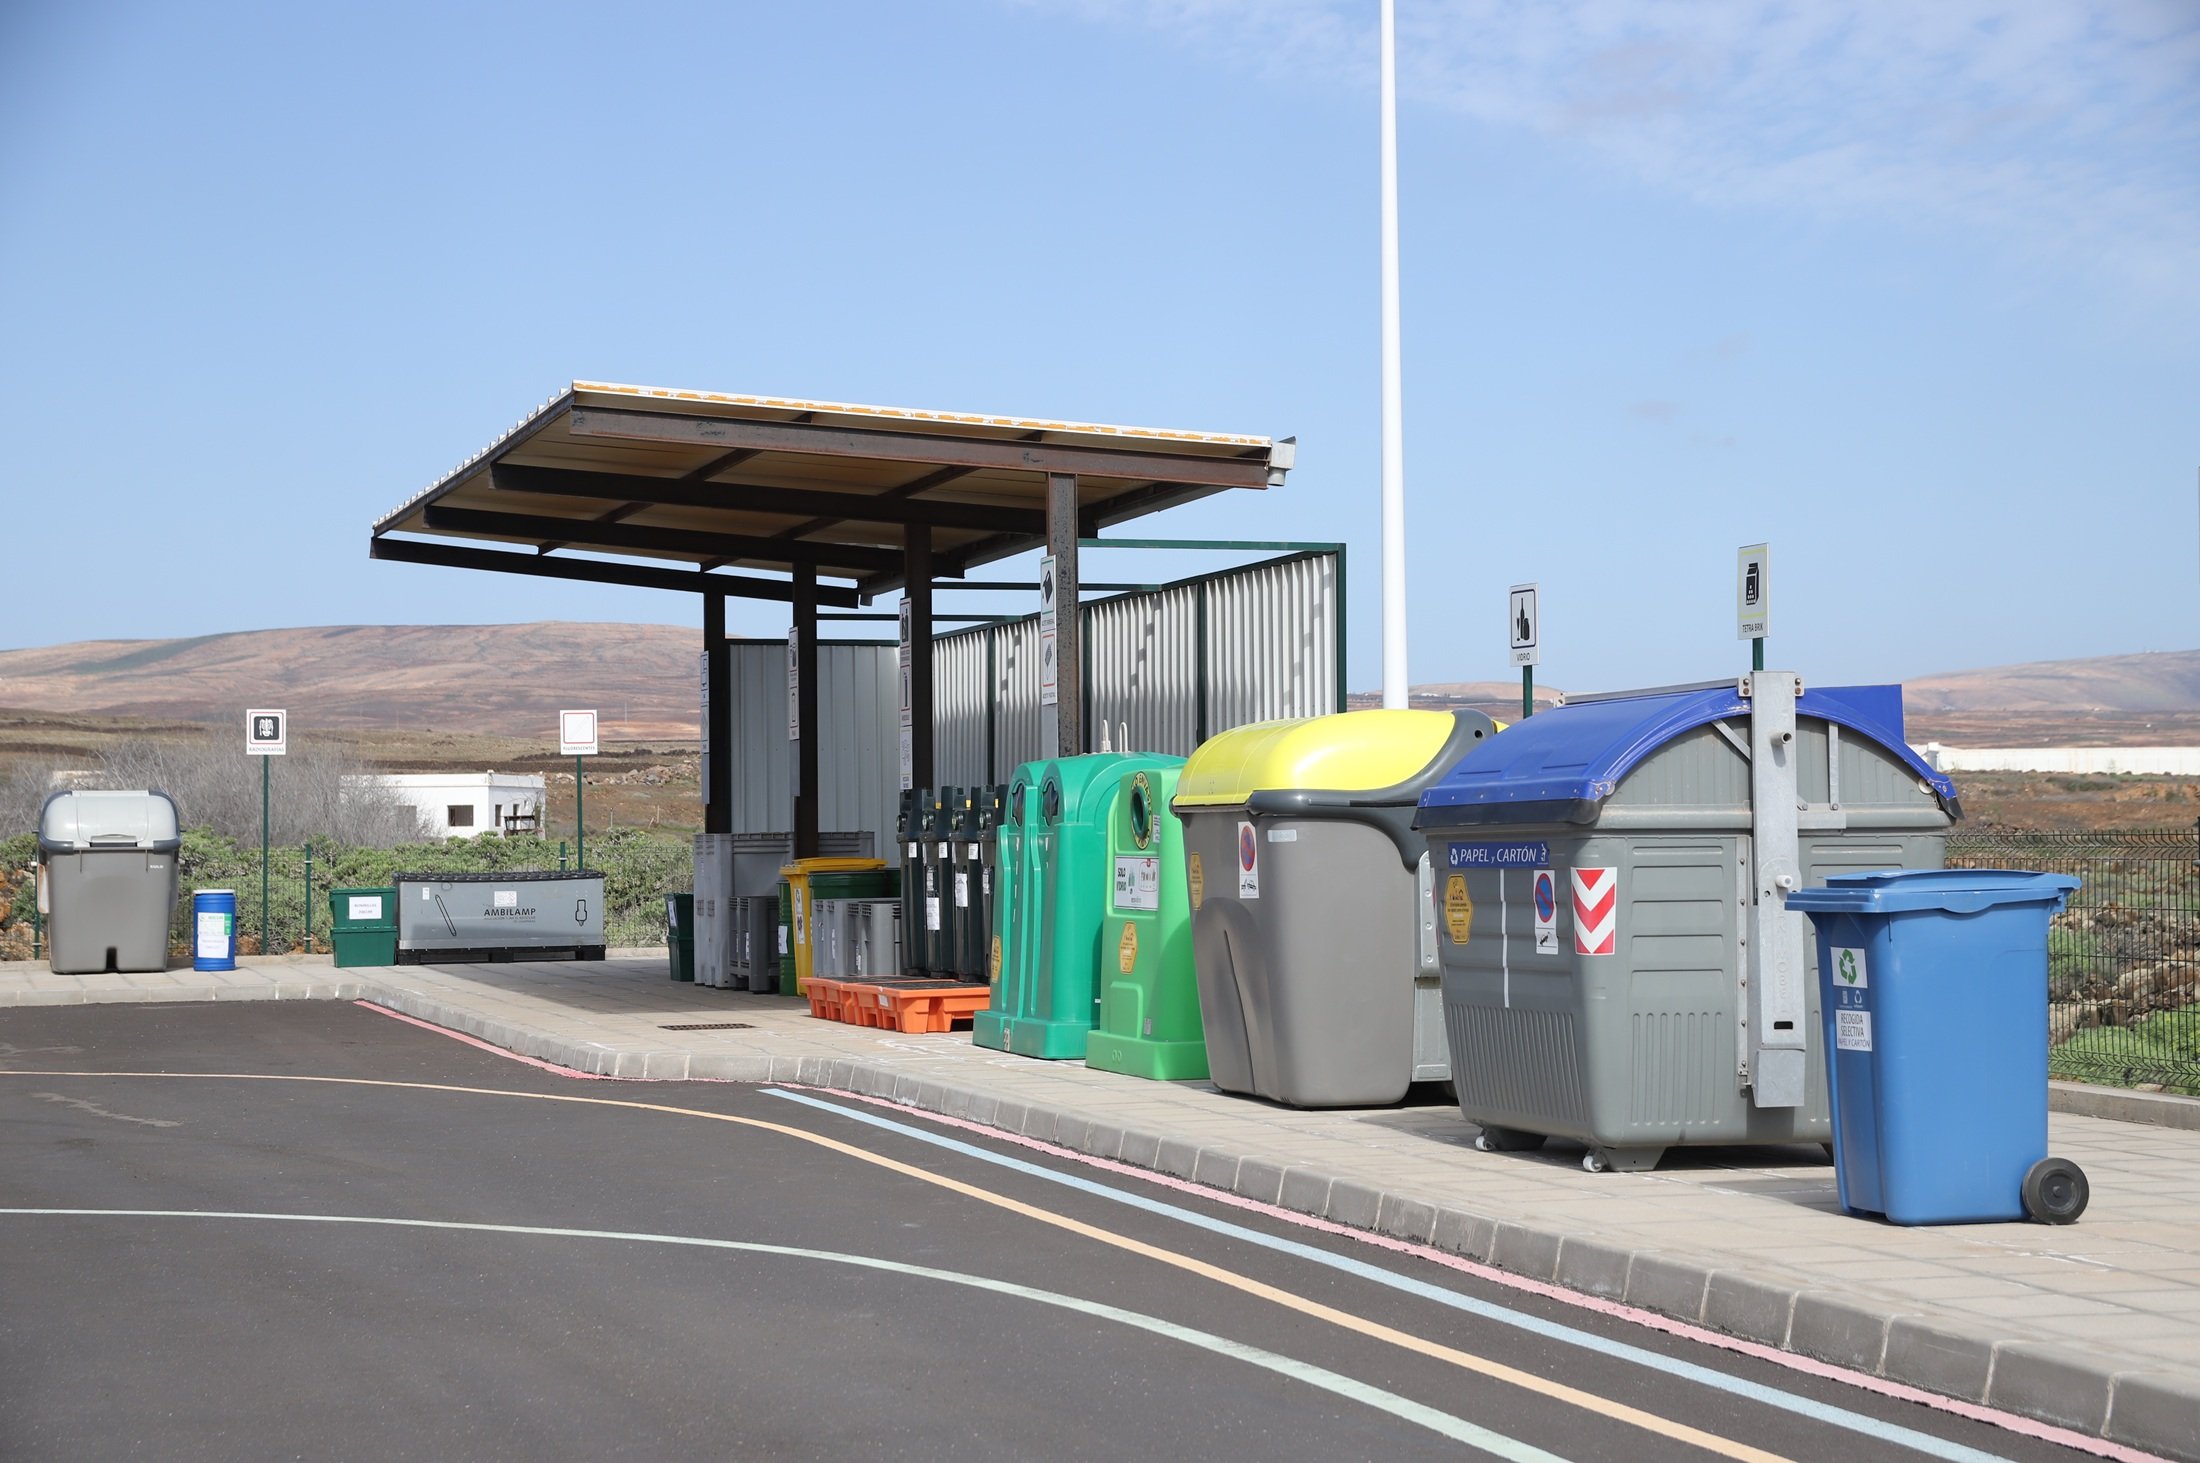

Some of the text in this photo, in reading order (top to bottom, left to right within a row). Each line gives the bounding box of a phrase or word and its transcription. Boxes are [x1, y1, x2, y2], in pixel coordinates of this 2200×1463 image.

[1517, 652, 1530, 661] VIDRIO
[1460, 848, 1489, 863] PAPEL
[1496, 845, 1537, 863] CARTÓN
[484, 908, 536, 916] AMBILAMP
[1840, 1013, 1864, 1025] RECOGIDA
[1840, 1025, 1865, 1038] SELECTIVA
